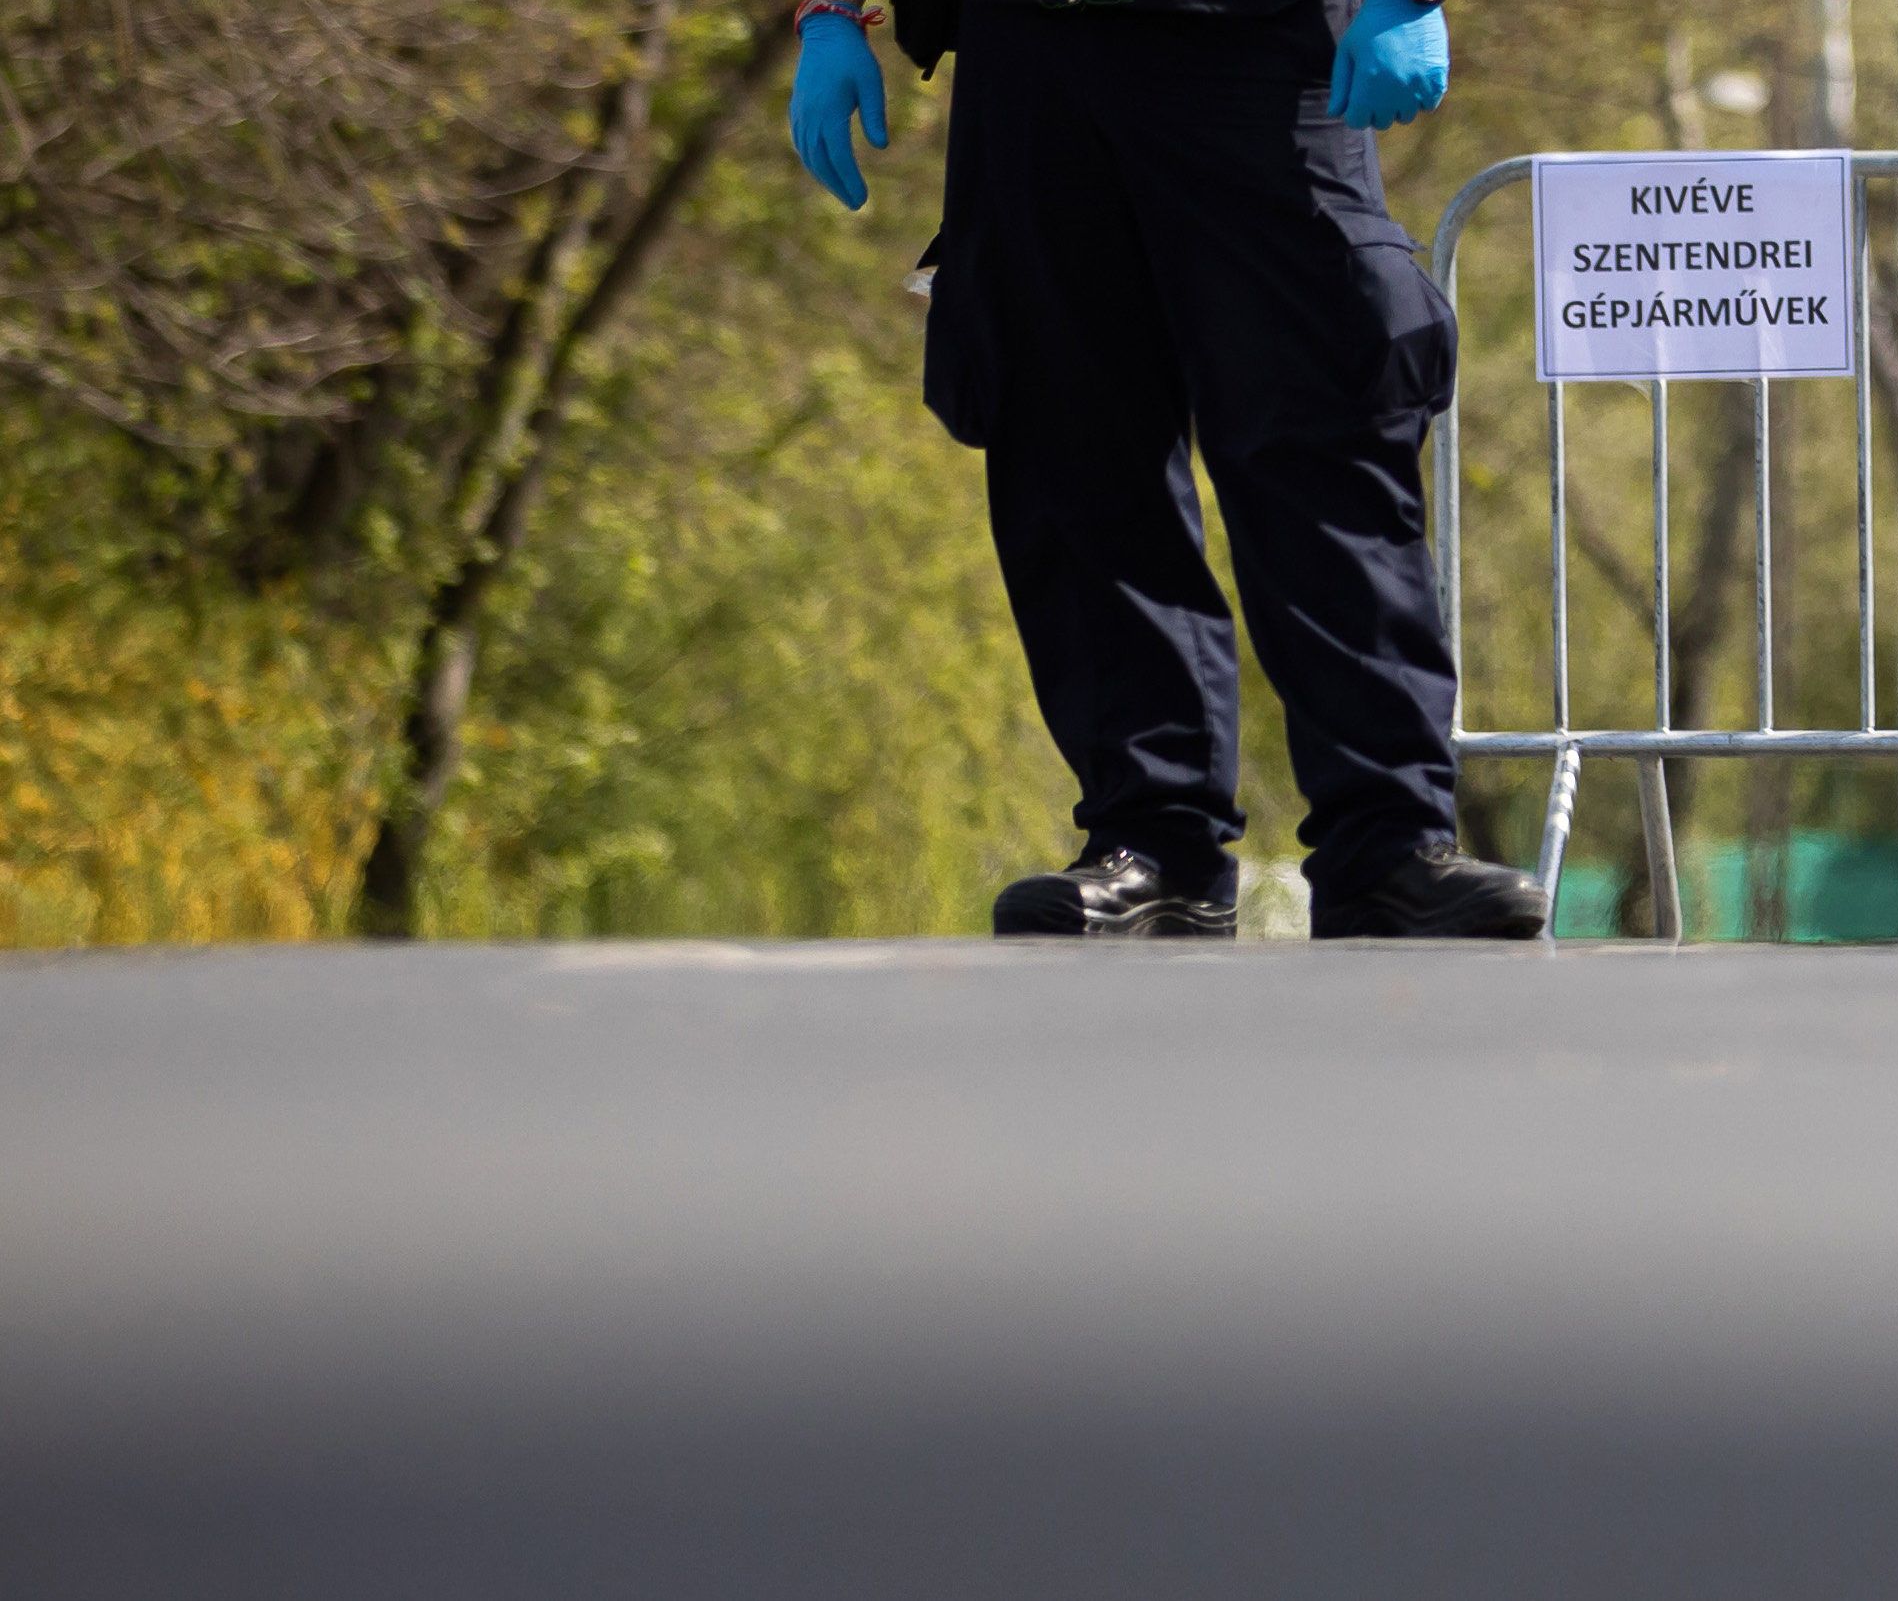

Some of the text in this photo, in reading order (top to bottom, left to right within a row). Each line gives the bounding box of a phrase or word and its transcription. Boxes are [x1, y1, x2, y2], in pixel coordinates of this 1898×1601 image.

[1631, 177, 1754, 214] KIVÉVE
[1573, 240, 1812, 273] SZENTENDREI
[1562, 288, 1829, 329] GÉPJÁRMŰVEK
